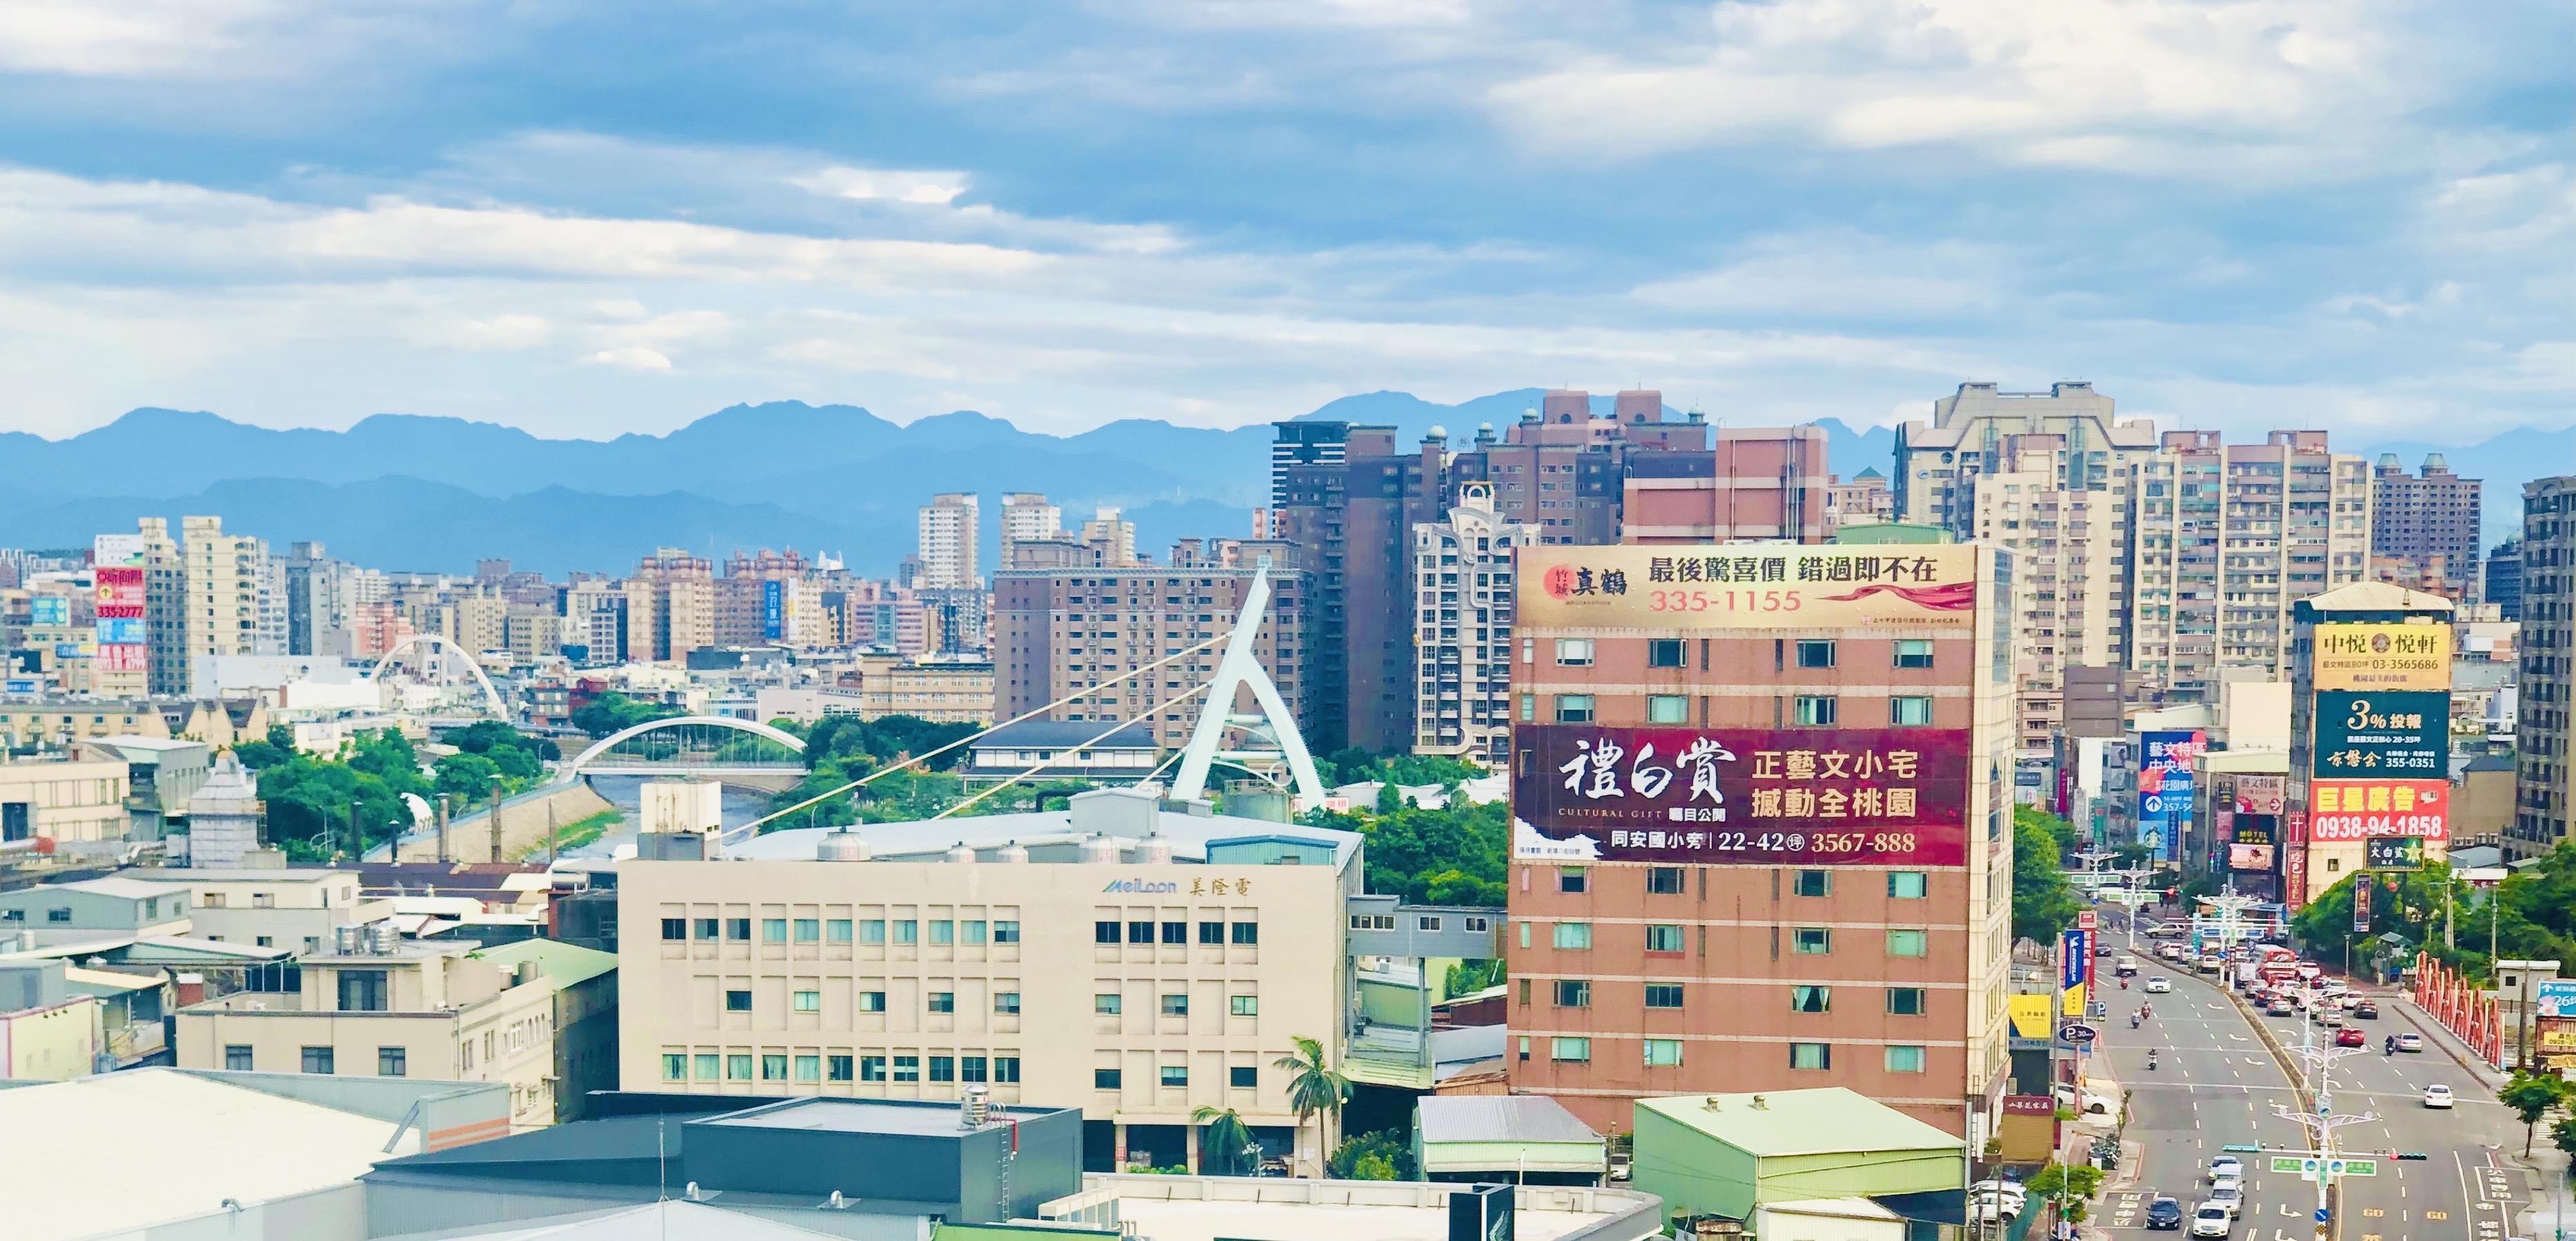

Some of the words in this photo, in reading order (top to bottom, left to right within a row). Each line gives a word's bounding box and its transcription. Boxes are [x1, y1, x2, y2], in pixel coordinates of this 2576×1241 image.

[1649, 556, 1786, 582] 最後驚喜價
[1797, 556, 1938, 582] 錯過即不在
[1571, 567, 1628, 596] 真鶴
[1649, 591, 1802, 612] 335-1155
[2372, 659, 2439, 670] 03-3565686
[2347, 699, 2387, 730] 3%
[2389, 713, 2421, 729] 投報
[2149, 741, 2206, 757] 藝文特區
[1752, 750, 1918, 779] 正藝文小宅
[2385, 757, 2435, 768] 355-0351
[2162, 779, 2193, 791] 花園廣
[1558, 808, 1623, 817] CULTURAL
[1631, 810, 1661, 818] GIFT
[1752, 788, 1916, 818] 撼動全桃園
[2316, 815, 2443, 838] 0938-94-1858
[1611, 830, 1704, 850] 同安國小旁
[1811, 833, 1916, 852] 3567-888
[2098, 1003, 2105, 1014] P
[2066, 1027, 2076, 1039] P
